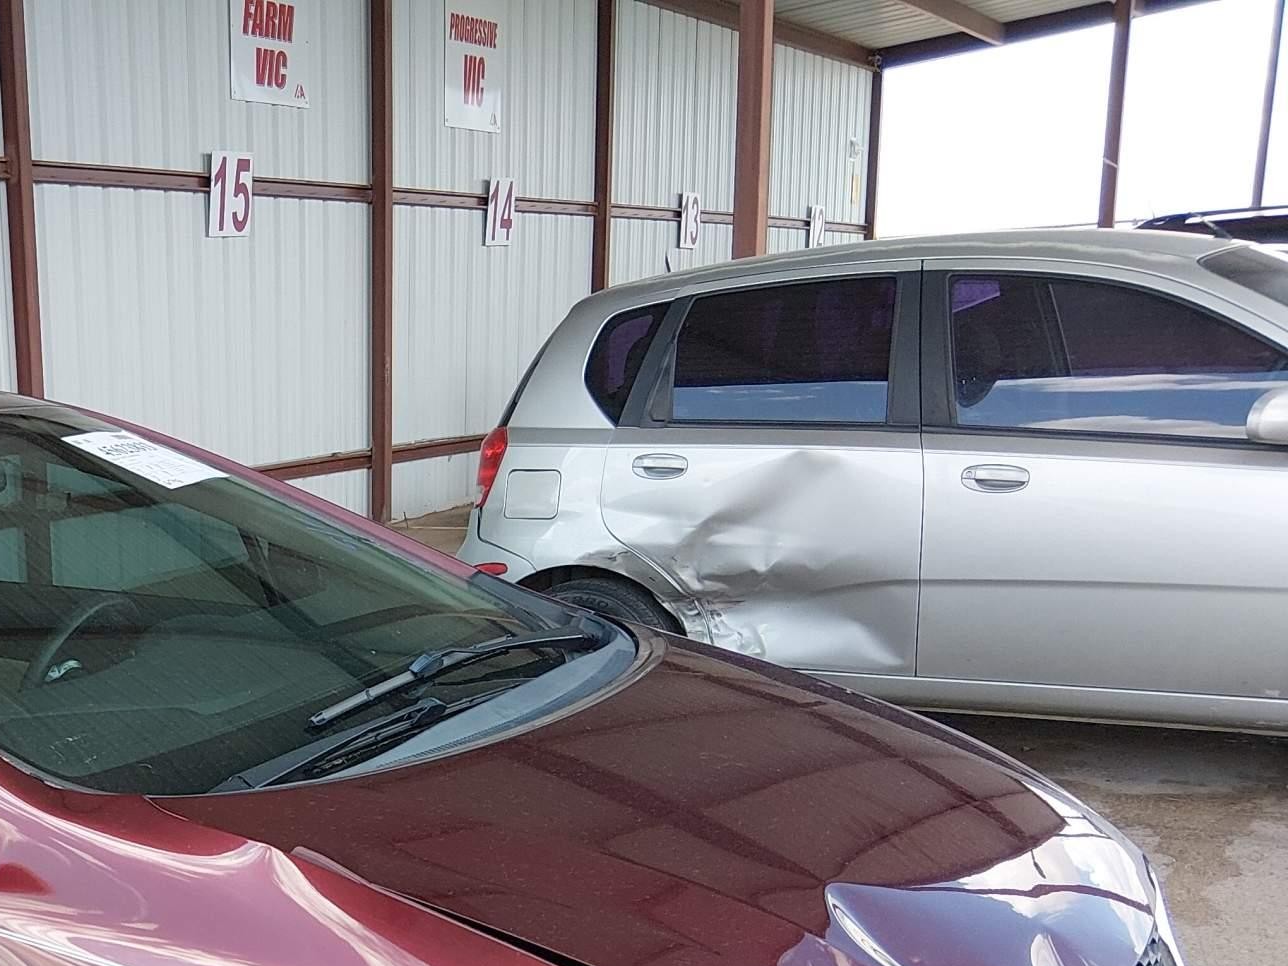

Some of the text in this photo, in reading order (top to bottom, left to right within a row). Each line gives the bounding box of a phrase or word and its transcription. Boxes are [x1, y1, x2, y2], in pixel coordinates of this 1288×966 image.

[242, 0, 296, 44] FARM
[449, 12, 498, 49] PROGRESSIVE
[255, 47, 289, 90] VIC
[463, 54, 486, 108] VIC
[214, 156, 251, 233] 15
[489, 180, 513, 241] 14
[682, 195, 699, 246] 13
[812, 207, 825, 247] 12
